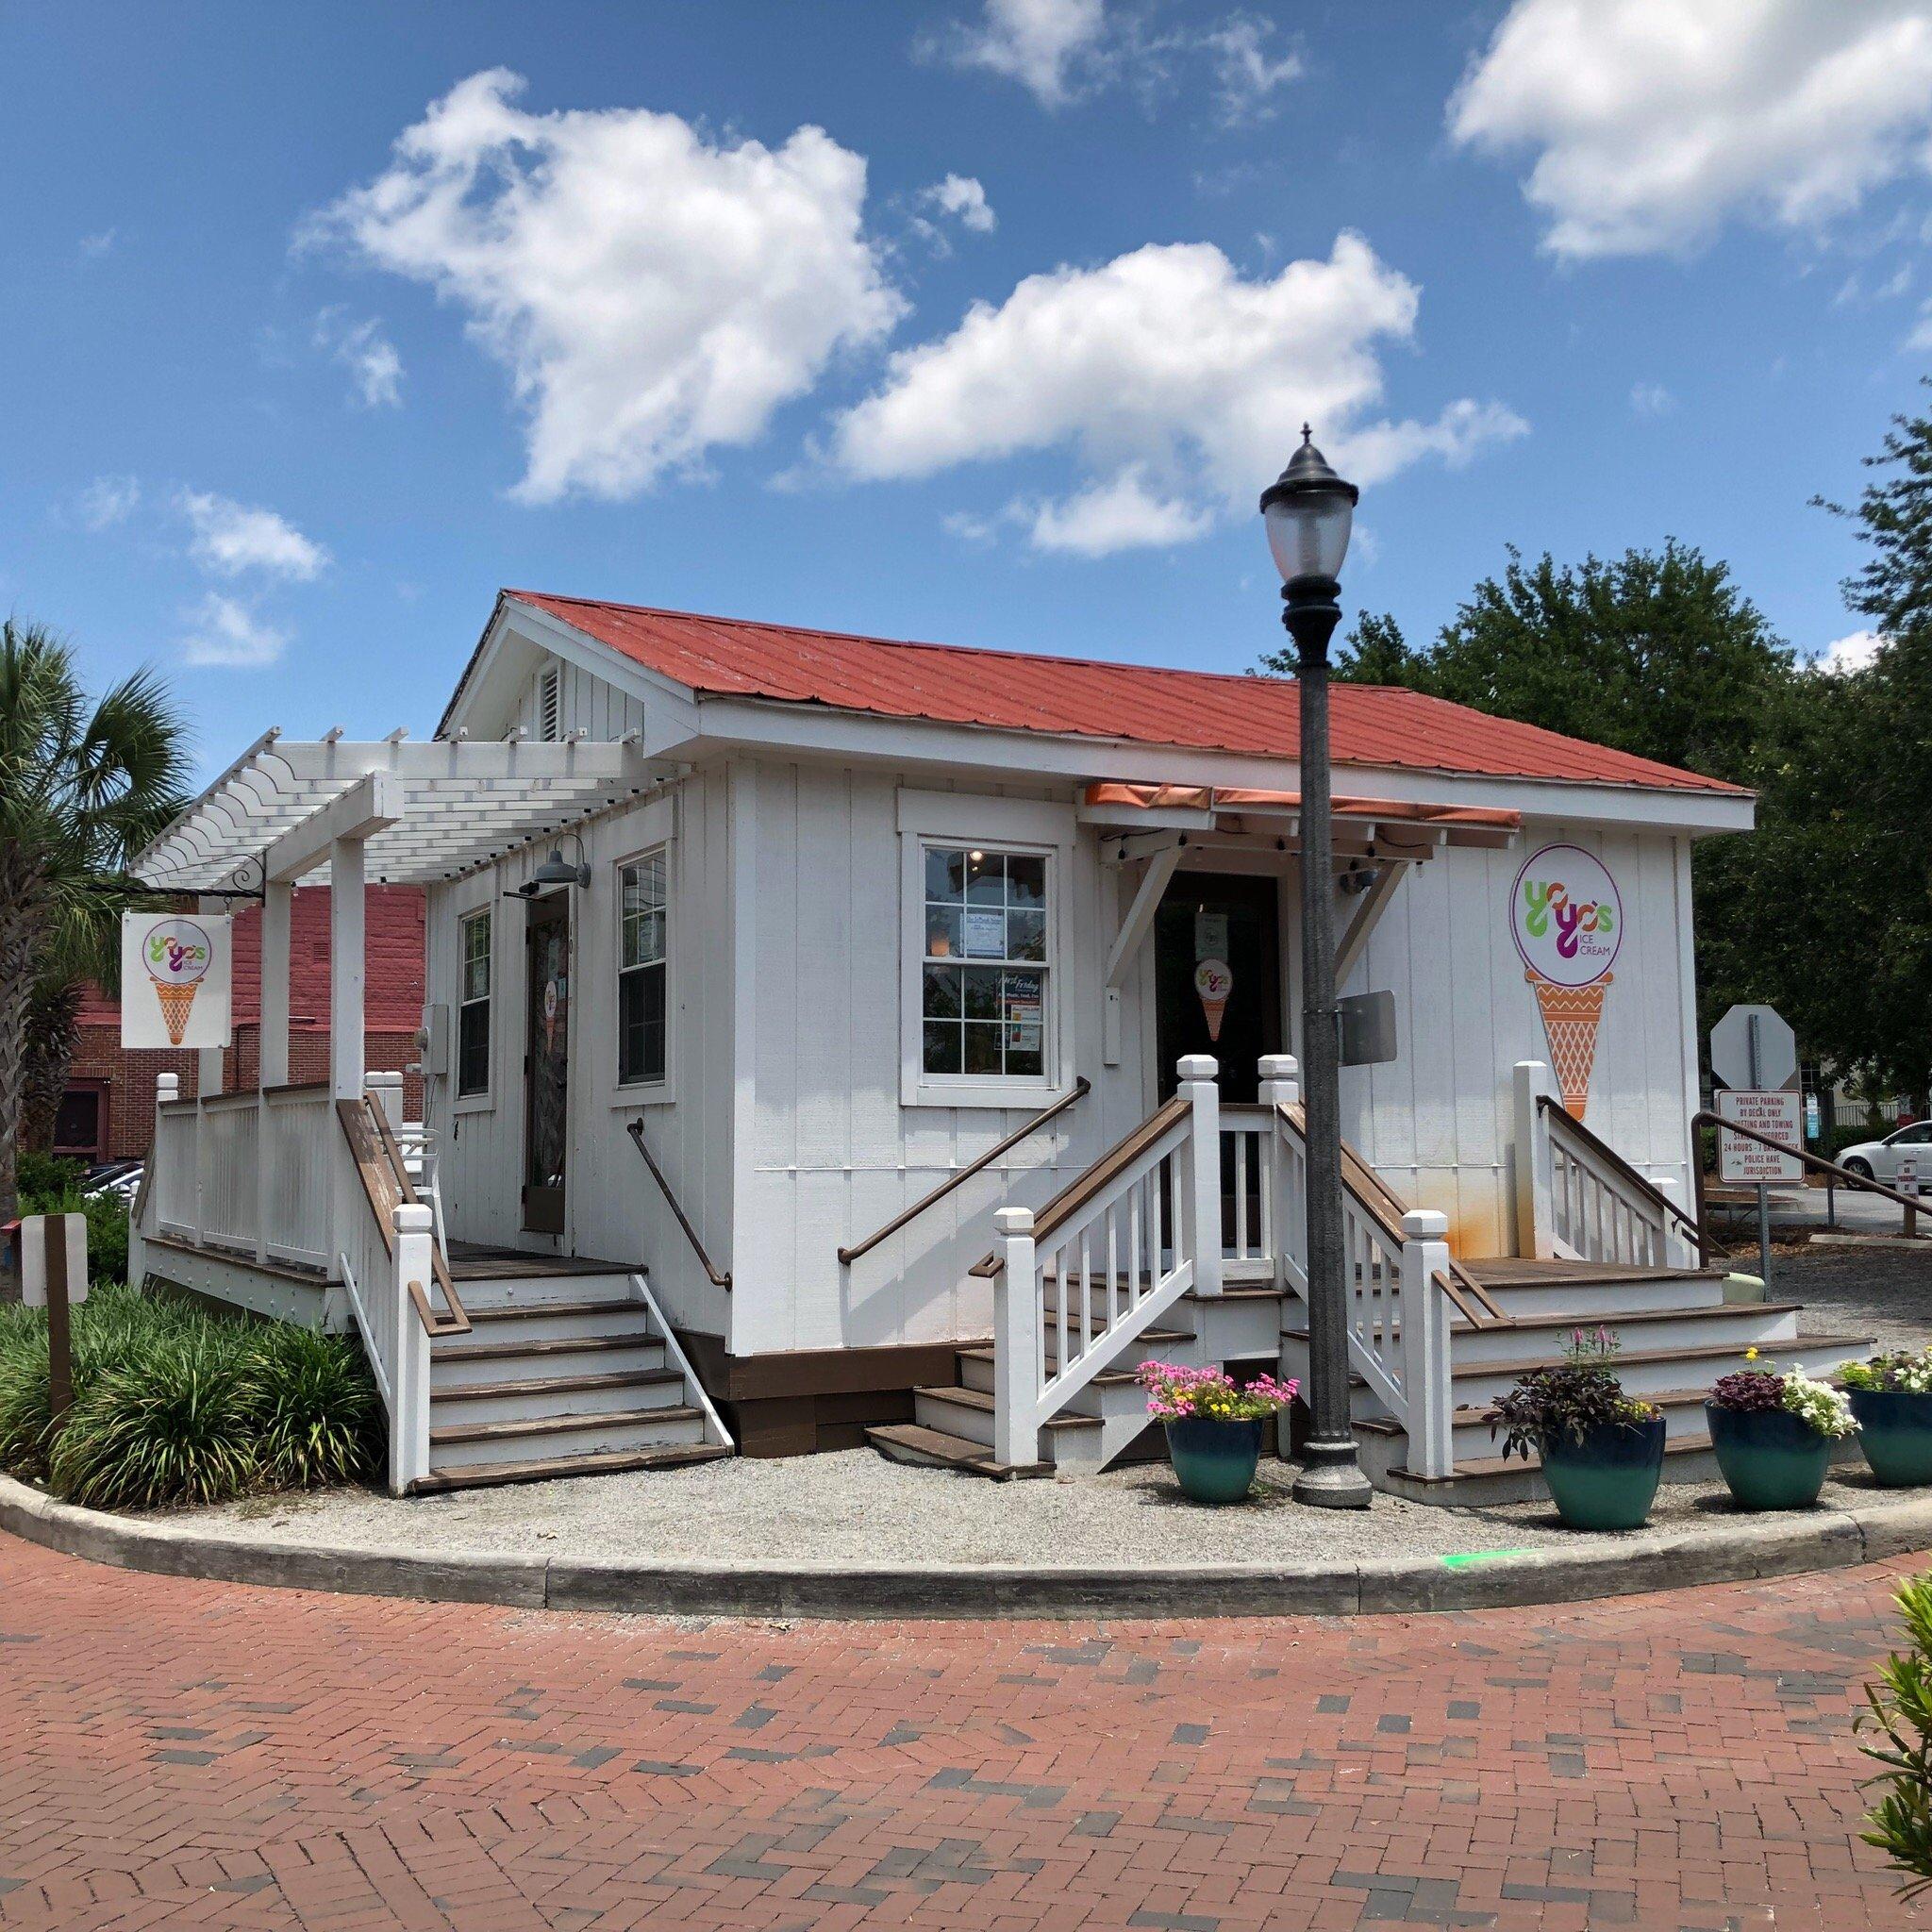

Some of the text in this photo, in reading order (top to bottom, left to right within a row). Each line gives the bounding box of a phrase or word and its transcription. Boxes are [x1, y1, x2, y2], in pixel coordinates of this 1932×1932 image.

[1580, 935, 1593, 944] ICE
[1580, 946, 1610, 956] CREAM
[1736, 1097, 1785, 1106] PRIVATE PARKING
[1740, 1108, 1781, 1117] BY DECAL ONLY
[1758, 1120, 1771, 1129] AND
[1772, 1120, 1793, 1129] TOWING
[1724, 1143, 1732, 1152] 24
[1734, 1143, 1753, 1152] HOURS
[1758, 1143, 1762, 1152] 7
[1744, 1156, 1781, 1164] POLICE HAVE
[1743, 1167, 1782, 1175] JURISDICTION
